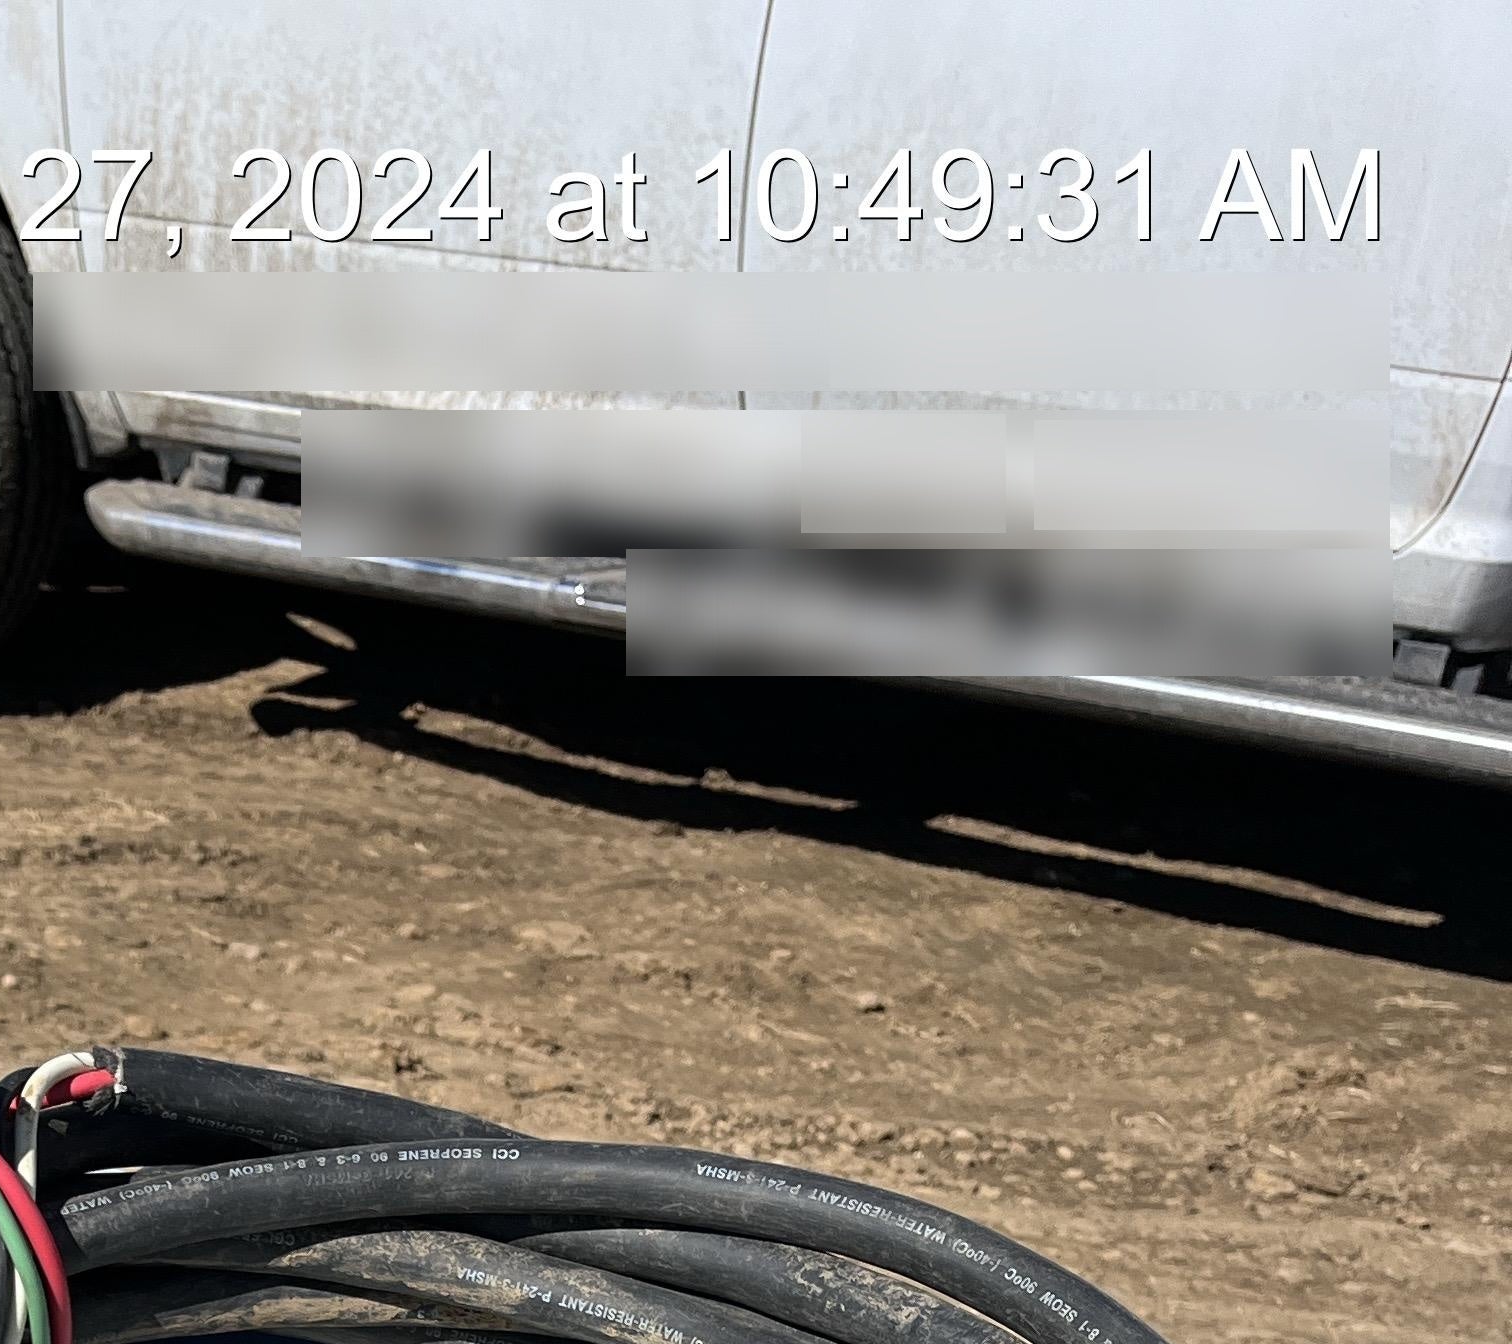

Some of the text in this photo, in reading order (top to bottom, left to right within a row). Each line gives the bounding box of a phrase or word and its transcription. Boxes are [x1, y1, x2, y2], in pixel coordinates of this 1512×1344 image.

[335, 1152, 362, 1167] 6-3
[370, 1149, 388, 1163] 90
[397, 1146, 482, 1161] SEOPRENE
[492, 1147, 520, 1161] CCI
[228, 1160, 274, 1179] SEOW
[807, 1186, 946, 1246] WATER-RESISTANT
[456, 1266, 552, 1302] P-241-3-MSHA
[1038, 1290, 1079, 1323] SEOW
[1078, 1320, 1100, 1341] 8-1
